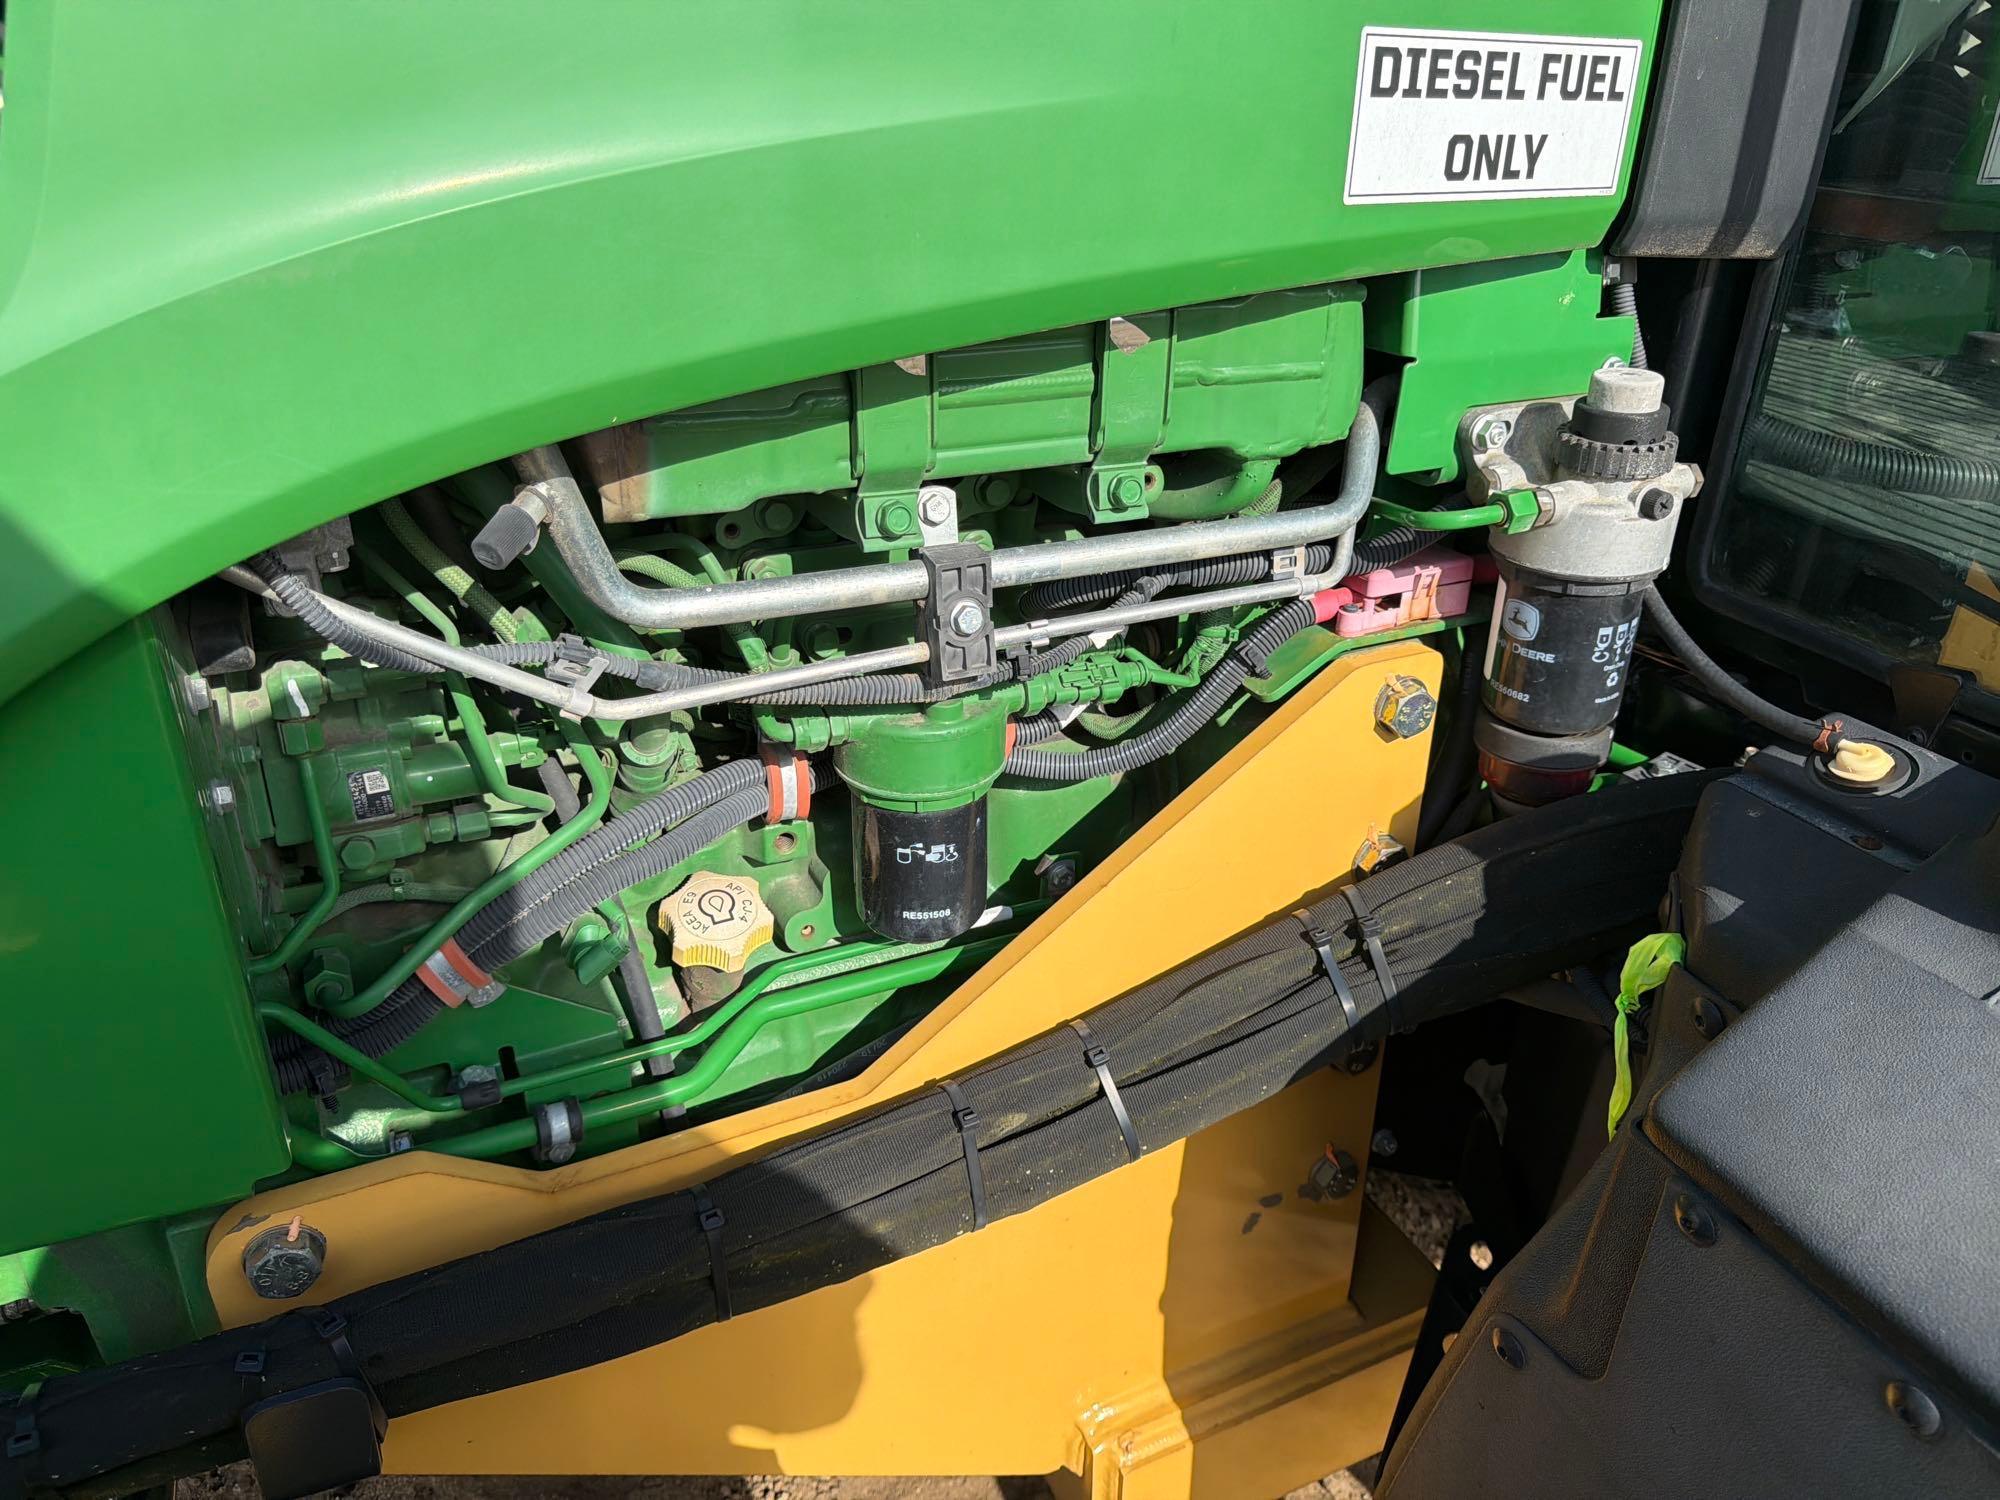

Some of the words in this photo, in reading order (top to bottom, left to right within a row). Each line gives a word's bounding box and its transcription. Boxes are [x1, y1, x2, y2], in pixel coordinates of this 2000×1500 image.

[1370, 46, 1525, 101] DIESEL
[1536, 53, 1625, 102] FUEL
[1443, 134, 1549, 181] ONLY
[1512, 643, 1556, 664] DEERE
[683, 891, 697, 904] E9
[725, 882, 746, 895] API
[738, 899, 753, 923] CJ-4
[682, 910, 710, 934] ACEA
[902, 908, 951, 920] RE551508
